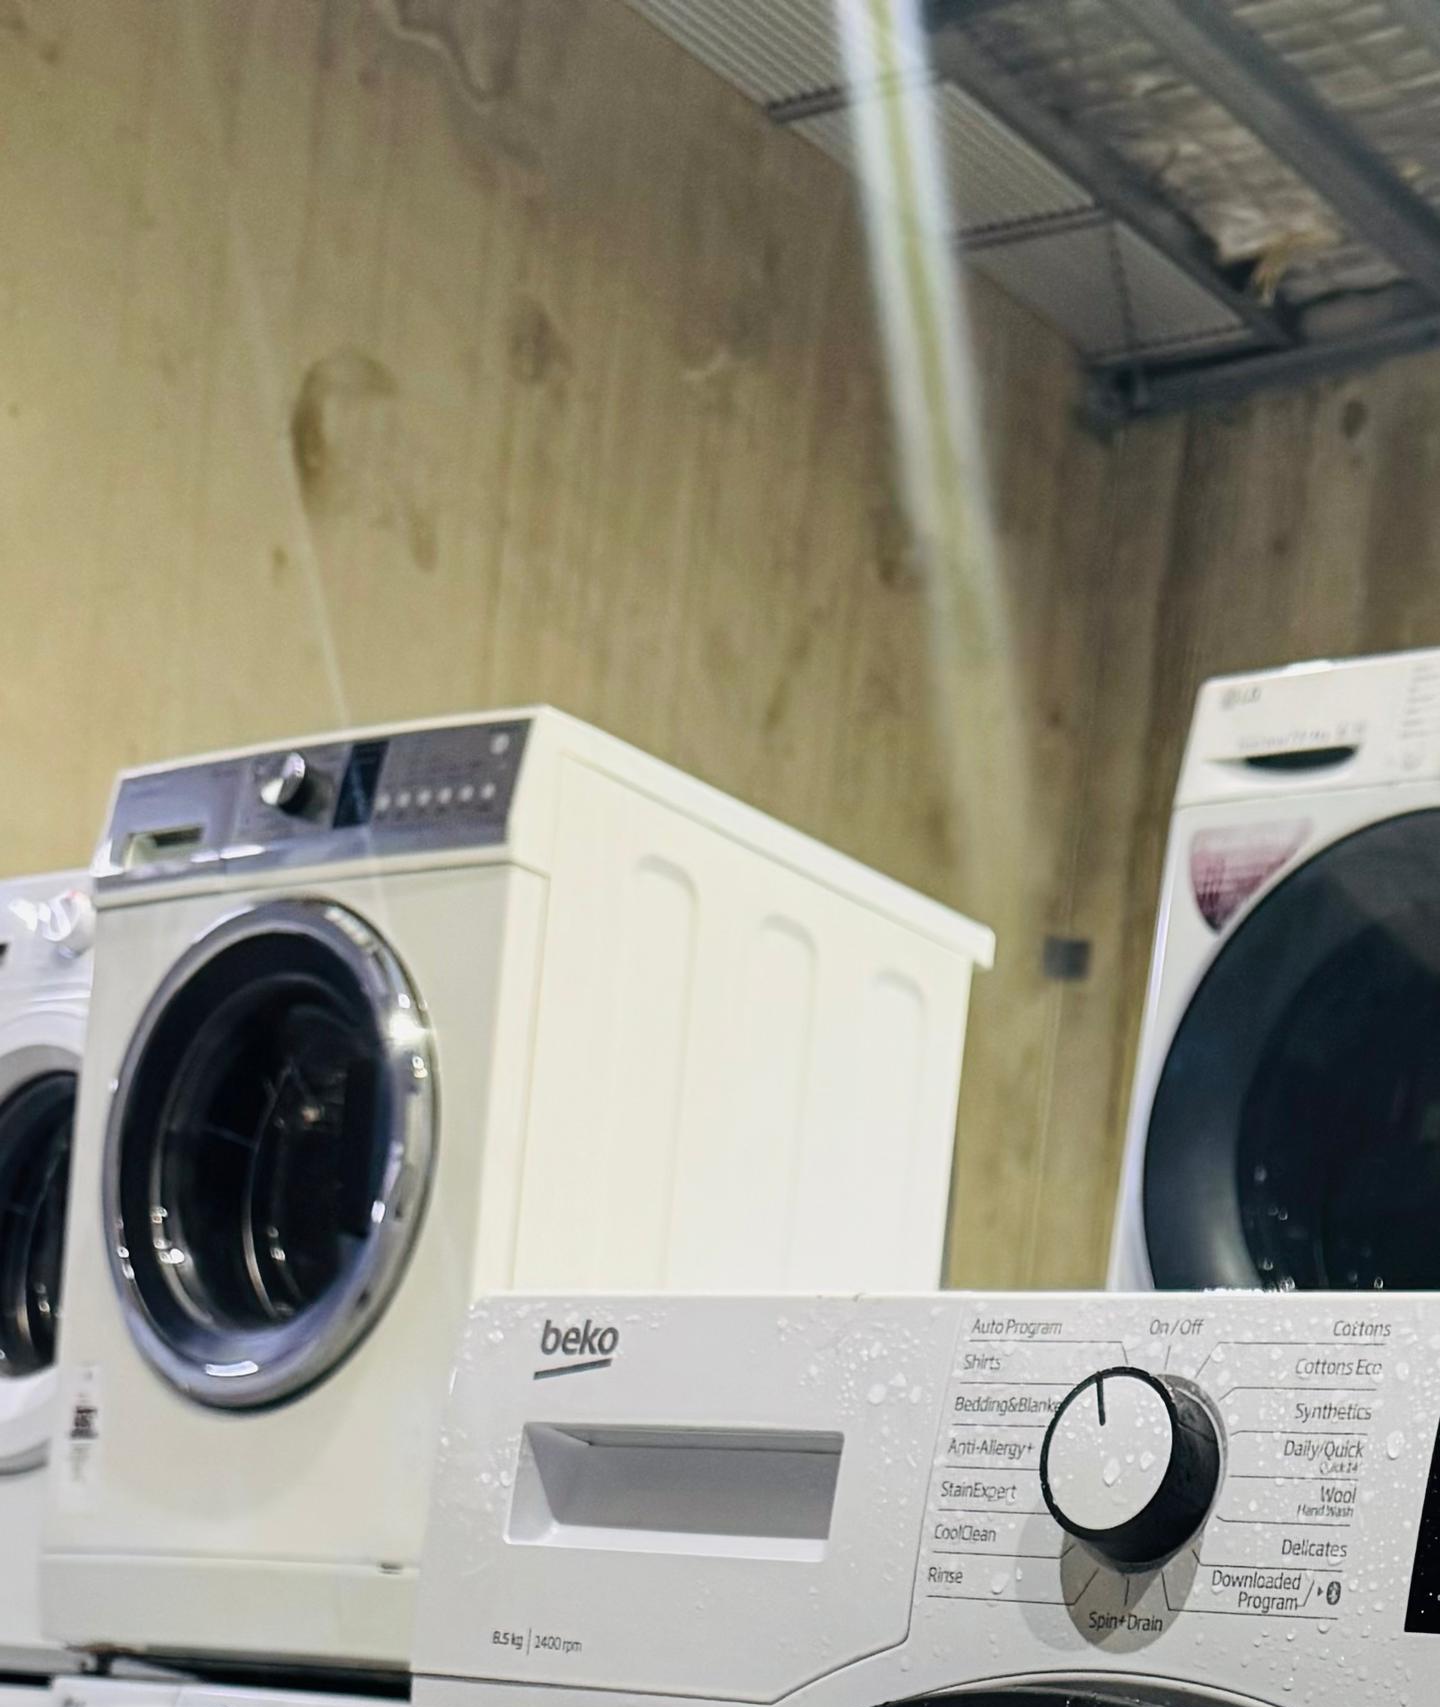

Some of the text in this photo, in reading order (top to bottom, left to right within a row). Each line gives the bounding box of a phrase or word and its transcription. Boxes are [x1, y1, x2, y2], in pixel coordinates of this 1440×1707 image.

[540, 1318, 620, 1356] beko
[971, 1319, 1063, 1338] Auto Program
[1150, 1319, 1170, 1335] On
[1180, 1319, 1204, 1335] Off
[1333, 1320, 1392, 1337] Cottons
[963, 1354, 1001, 1370] Shirts
[1295, 1358, 1383, 1376] Cottons Eco
[1295, 1402, 1372, 1424] Synthetics
[948, 1439, 1036, 1459] Anti-Allergy+
[1283, 1439, 1365, 1461] Daily/Quick
[941, 1481, 1017, 1502] StainExpert
[1320, 1485, 1357, 1504] Wool
[934, 1523, 997, 1543] CoolClean
[1281, 1539, 1348, 1558] Delicates
[927, 1566, 964, 1584] Rinse
[1212, 1569, 1302, 1591] Downloaded
[1237, 1591, 1299, 1614] Program
[1088, 1611, 1163, 1632] Spin+Drain
